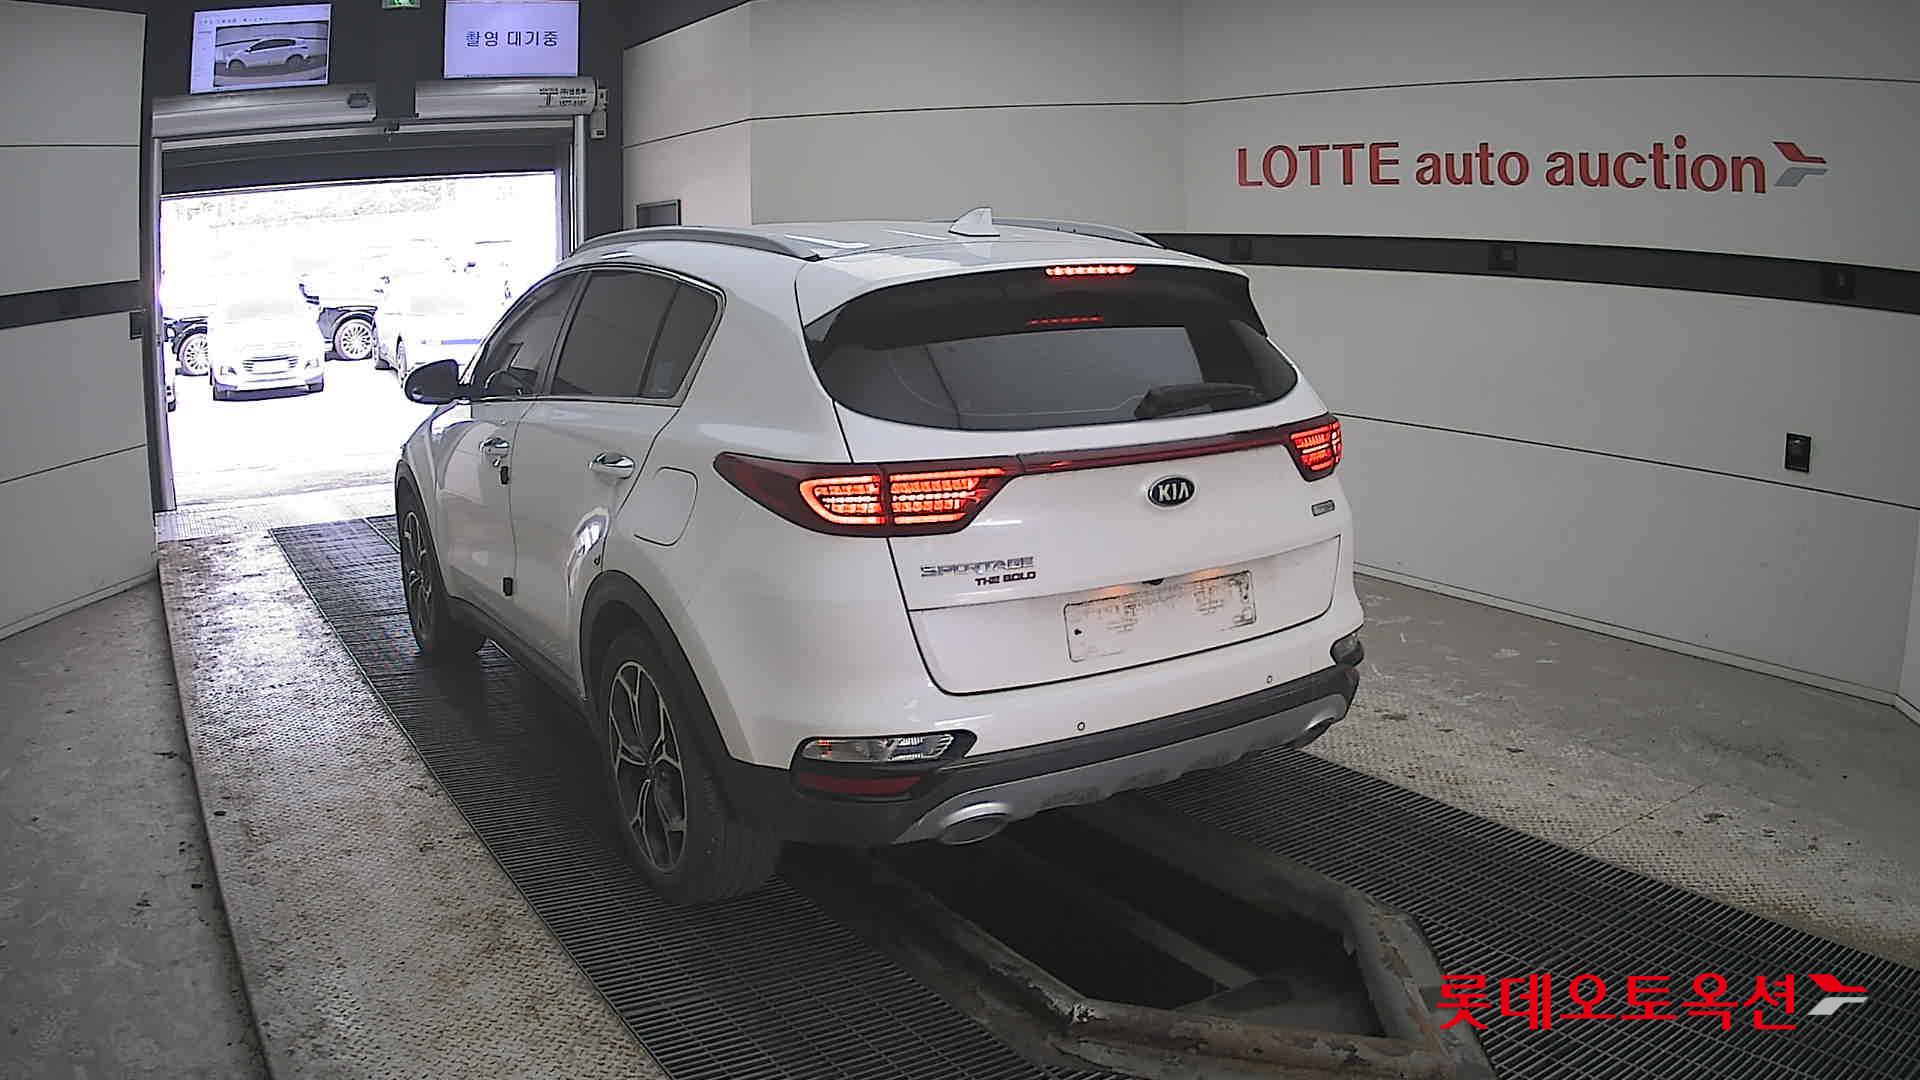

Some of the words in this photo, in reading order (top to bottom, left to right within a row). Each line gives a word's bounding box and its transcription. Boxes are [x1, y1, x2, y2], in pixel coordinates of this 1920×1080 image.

[507, 30, 559, 47] 대기중
[1237, 141, 1400, 188] LOTTE
[1415, 141, 1530, 187] auto
[1543, 135, 1767, 194] auction
[1157, 481, 1190, 502] KIA
[920, 556, 1034, 577] SPORTAGE
[975, 575, 1001, 586] THE
[1002, 571, 1037, 583] BOLD
